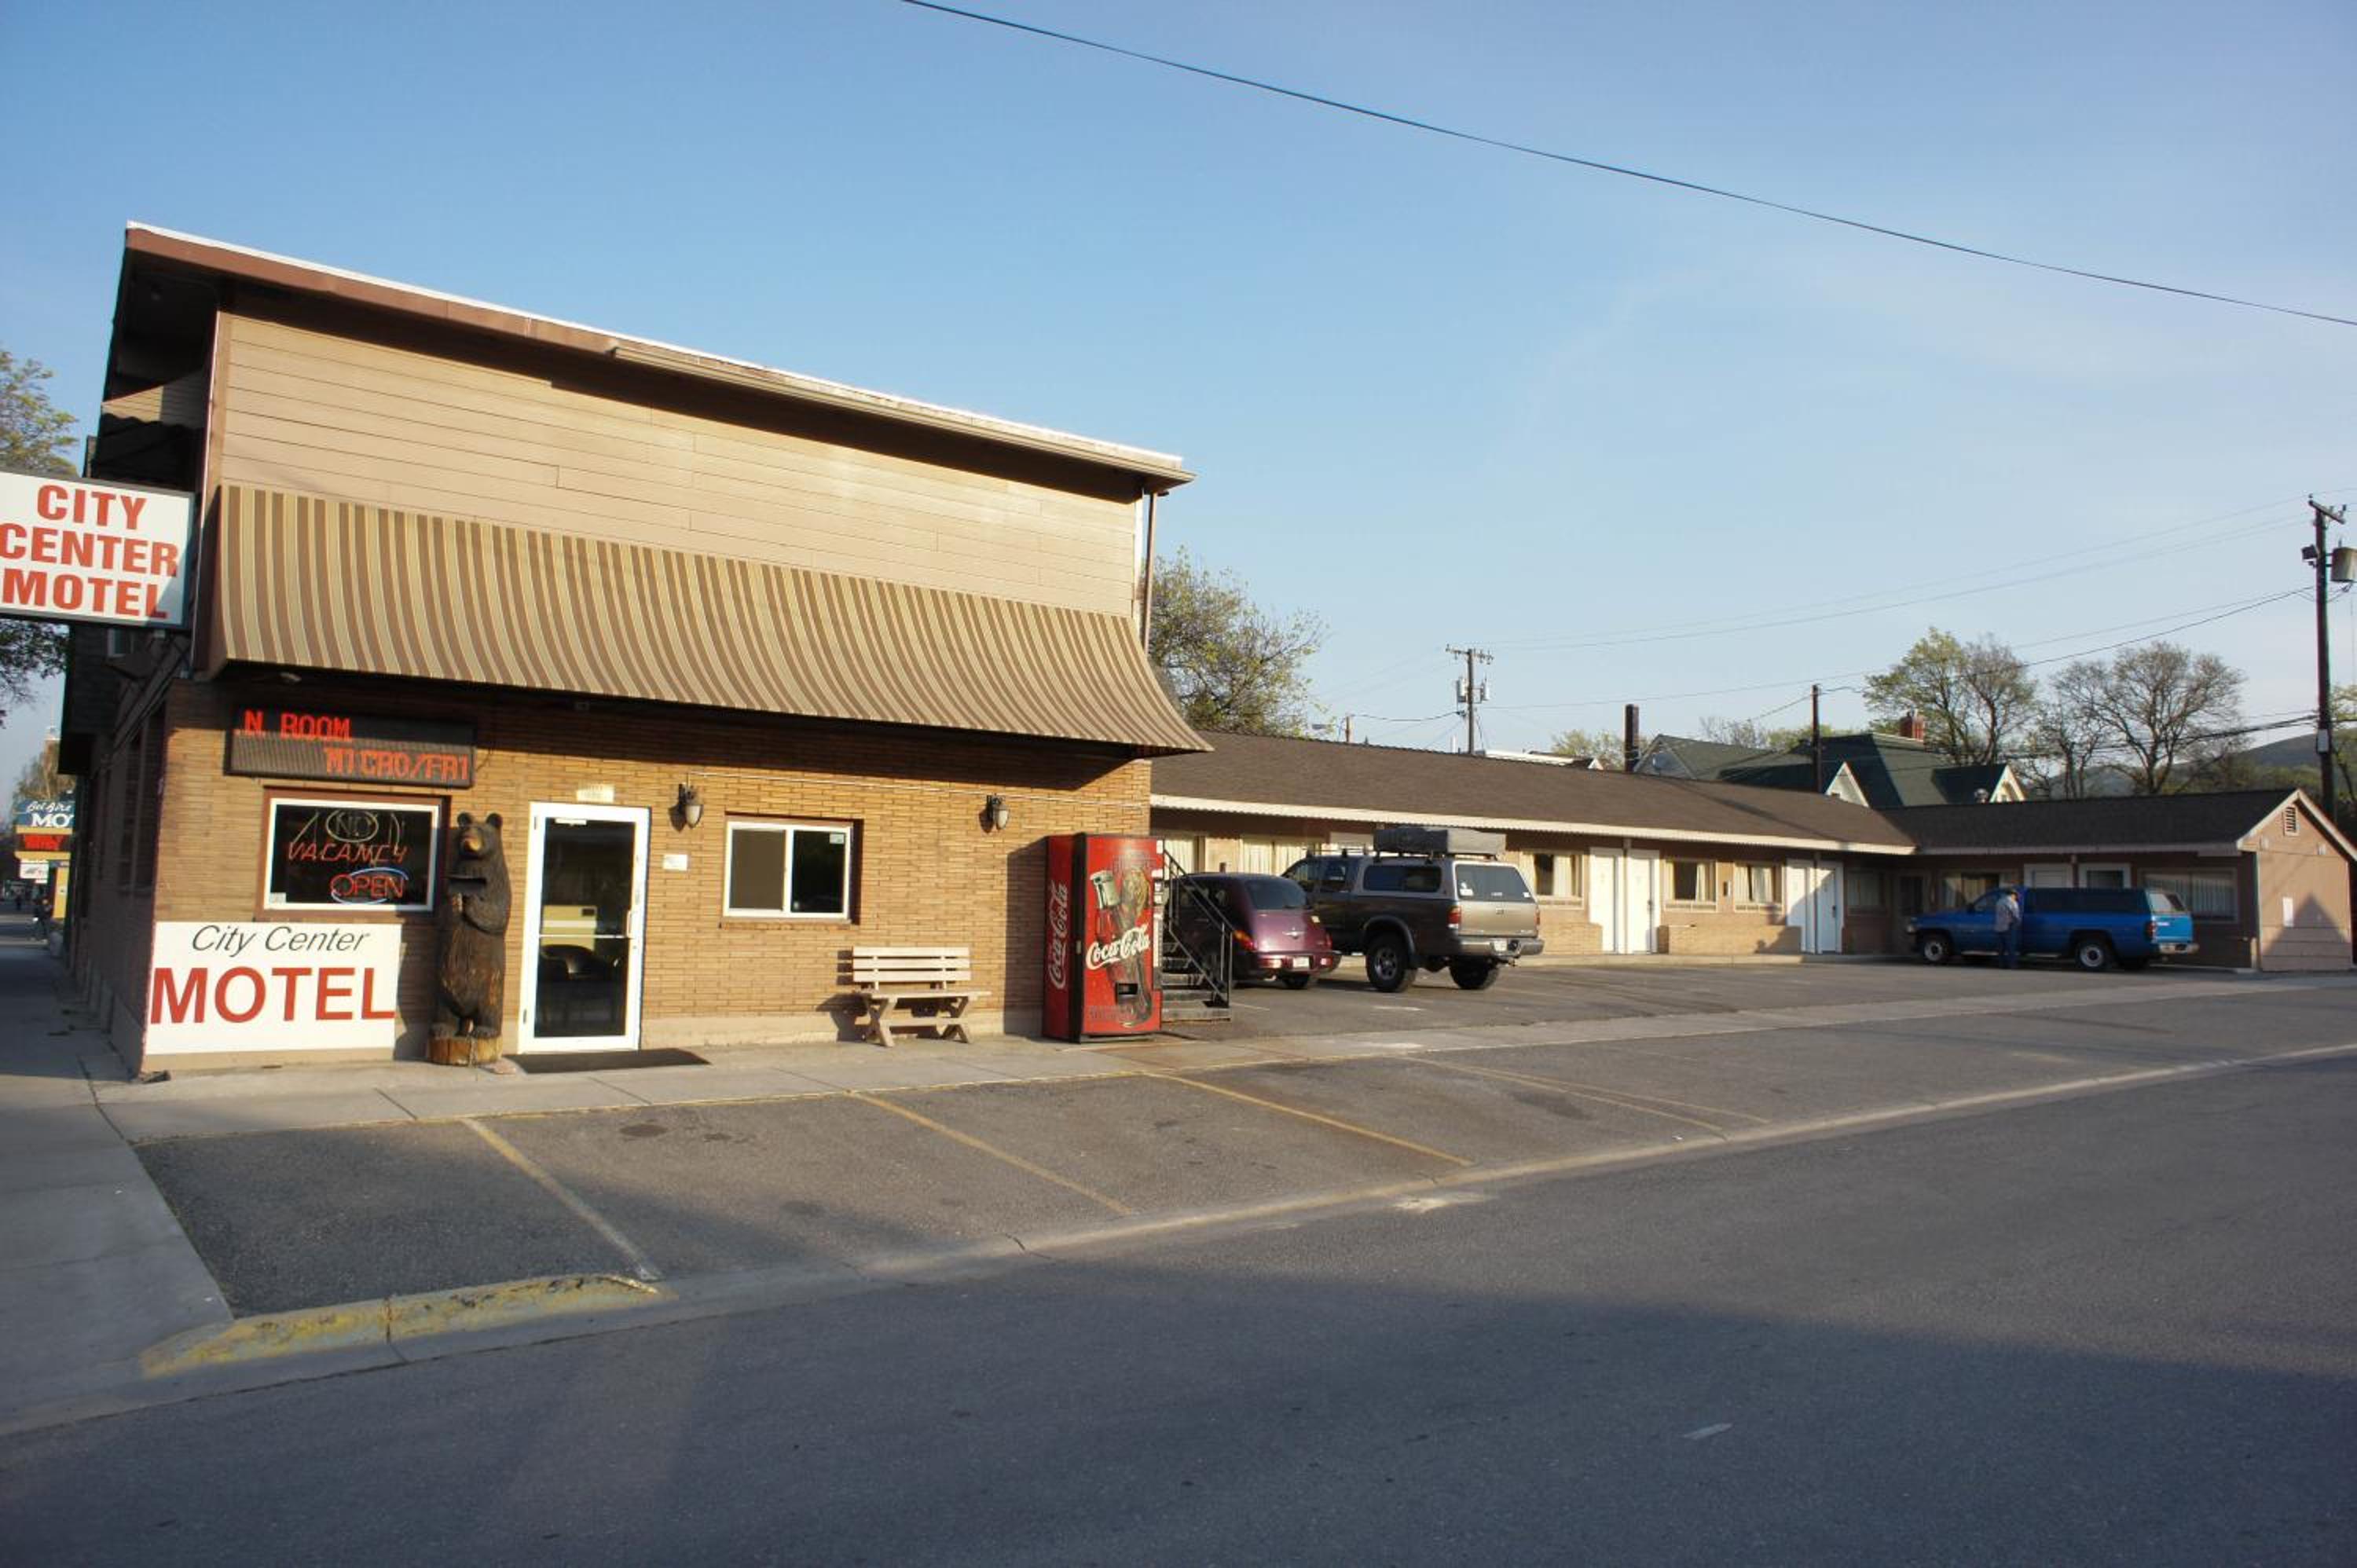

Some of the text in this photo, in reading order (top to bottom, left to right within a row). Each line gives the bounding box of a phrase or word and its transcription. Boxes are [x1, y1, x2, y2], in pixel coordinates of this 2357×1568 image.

[37, 484, 148, 530] CITY
[0, 522, 179, 577] CENTER
[2, 568, 167, 618] MOTEL
[288, 841, 407, 863] VACANCY
[330, 874, 404, 898] OPEN
[192, 925, 371, 958] City Center
[150, 966, 396, 1024] MOTEL
